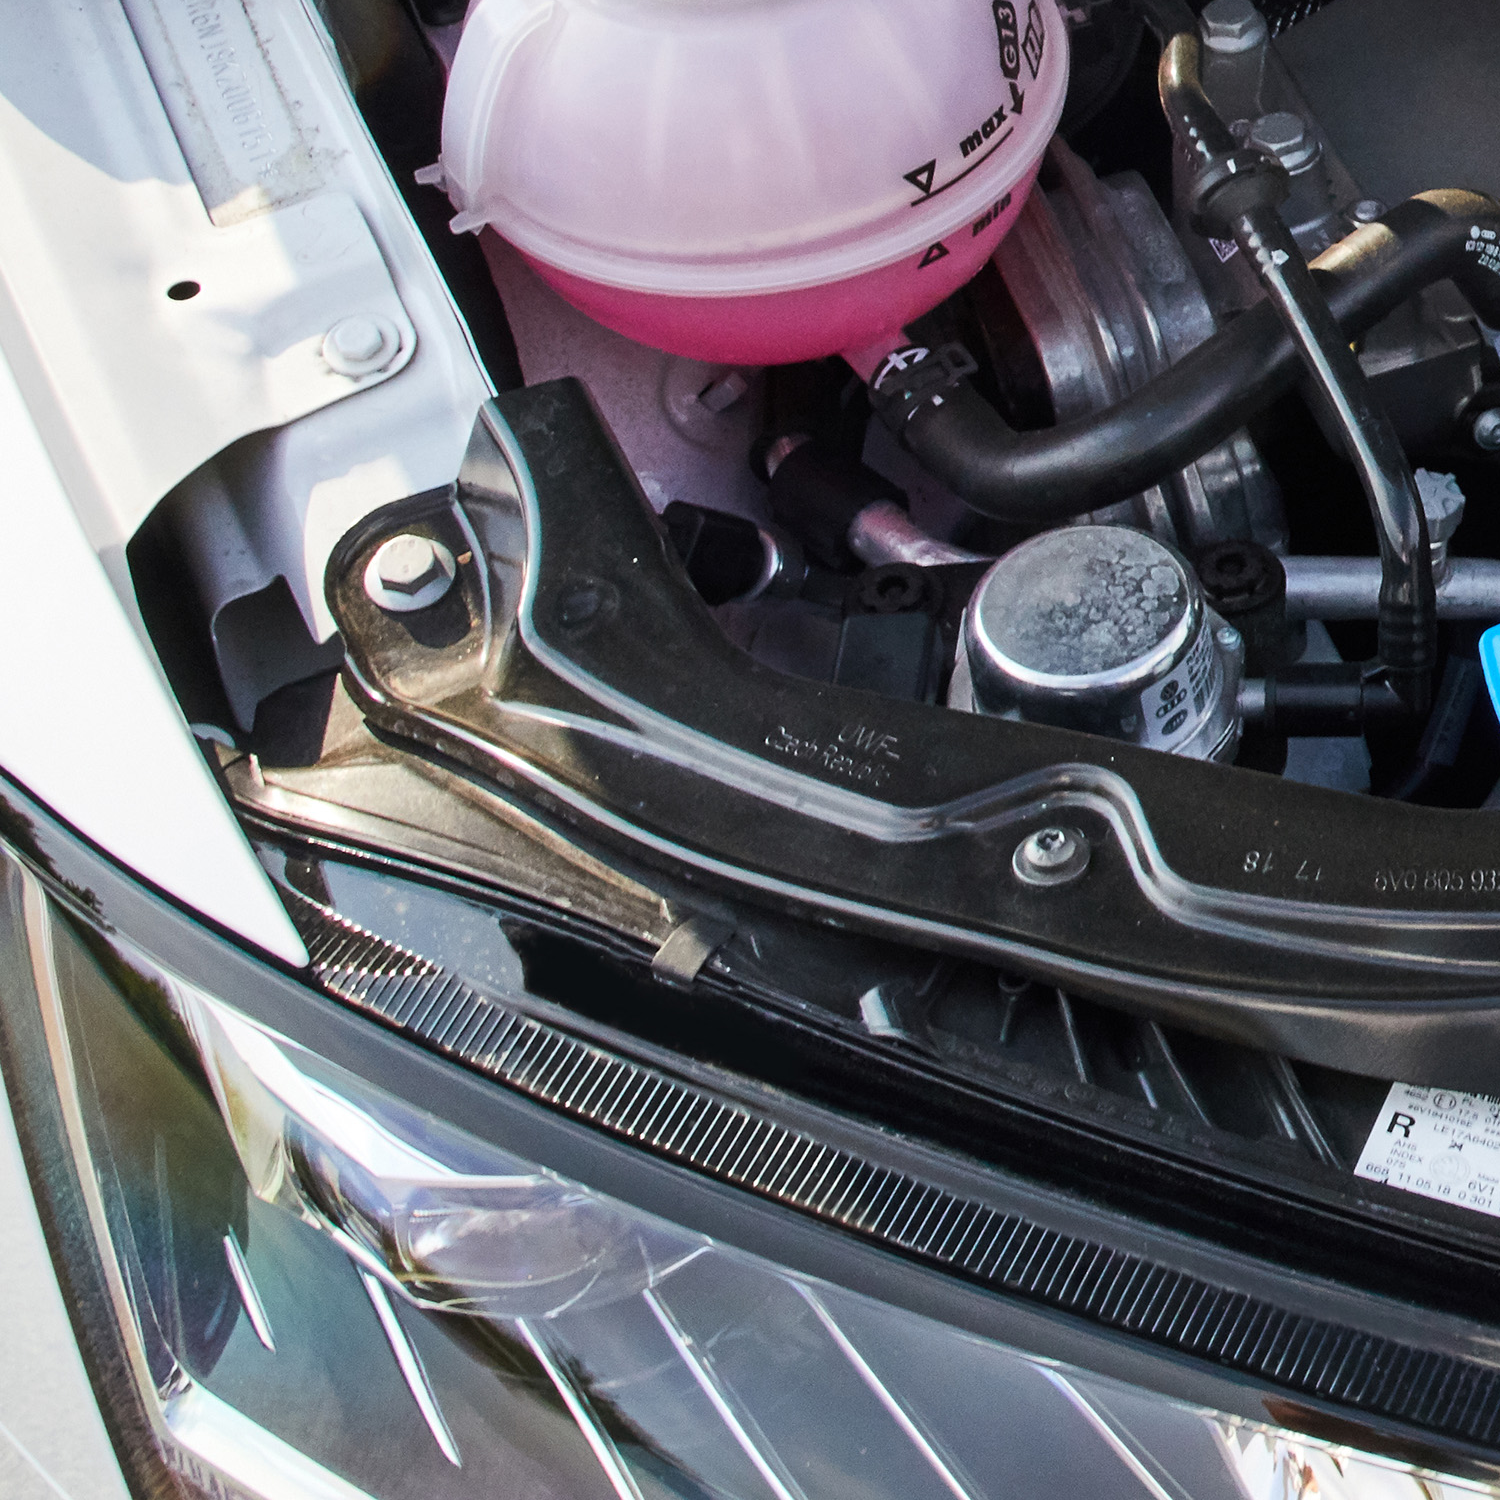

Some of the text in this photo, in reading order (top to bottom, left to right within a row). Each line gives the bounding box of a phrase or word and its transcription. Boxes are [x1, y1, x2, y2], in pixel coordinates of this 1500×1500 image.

[998, 4, 1018, 71] G13
[959, 104, 1008, 158] max
[972, 192, 1012, 237] min
[1424, 868, 1464, 892] 805
[1385, 1111, 1418, 1138] R
[1388, 1147, 1425, 1164] INDEX
[1396, 1172, 1453, 1196] 11.05.18
[1456, 1190, 1467, 1200] 0
[1468, 1193, 1493, 1208] 301
[1465, 1180, 1496, 1196] 6V1
